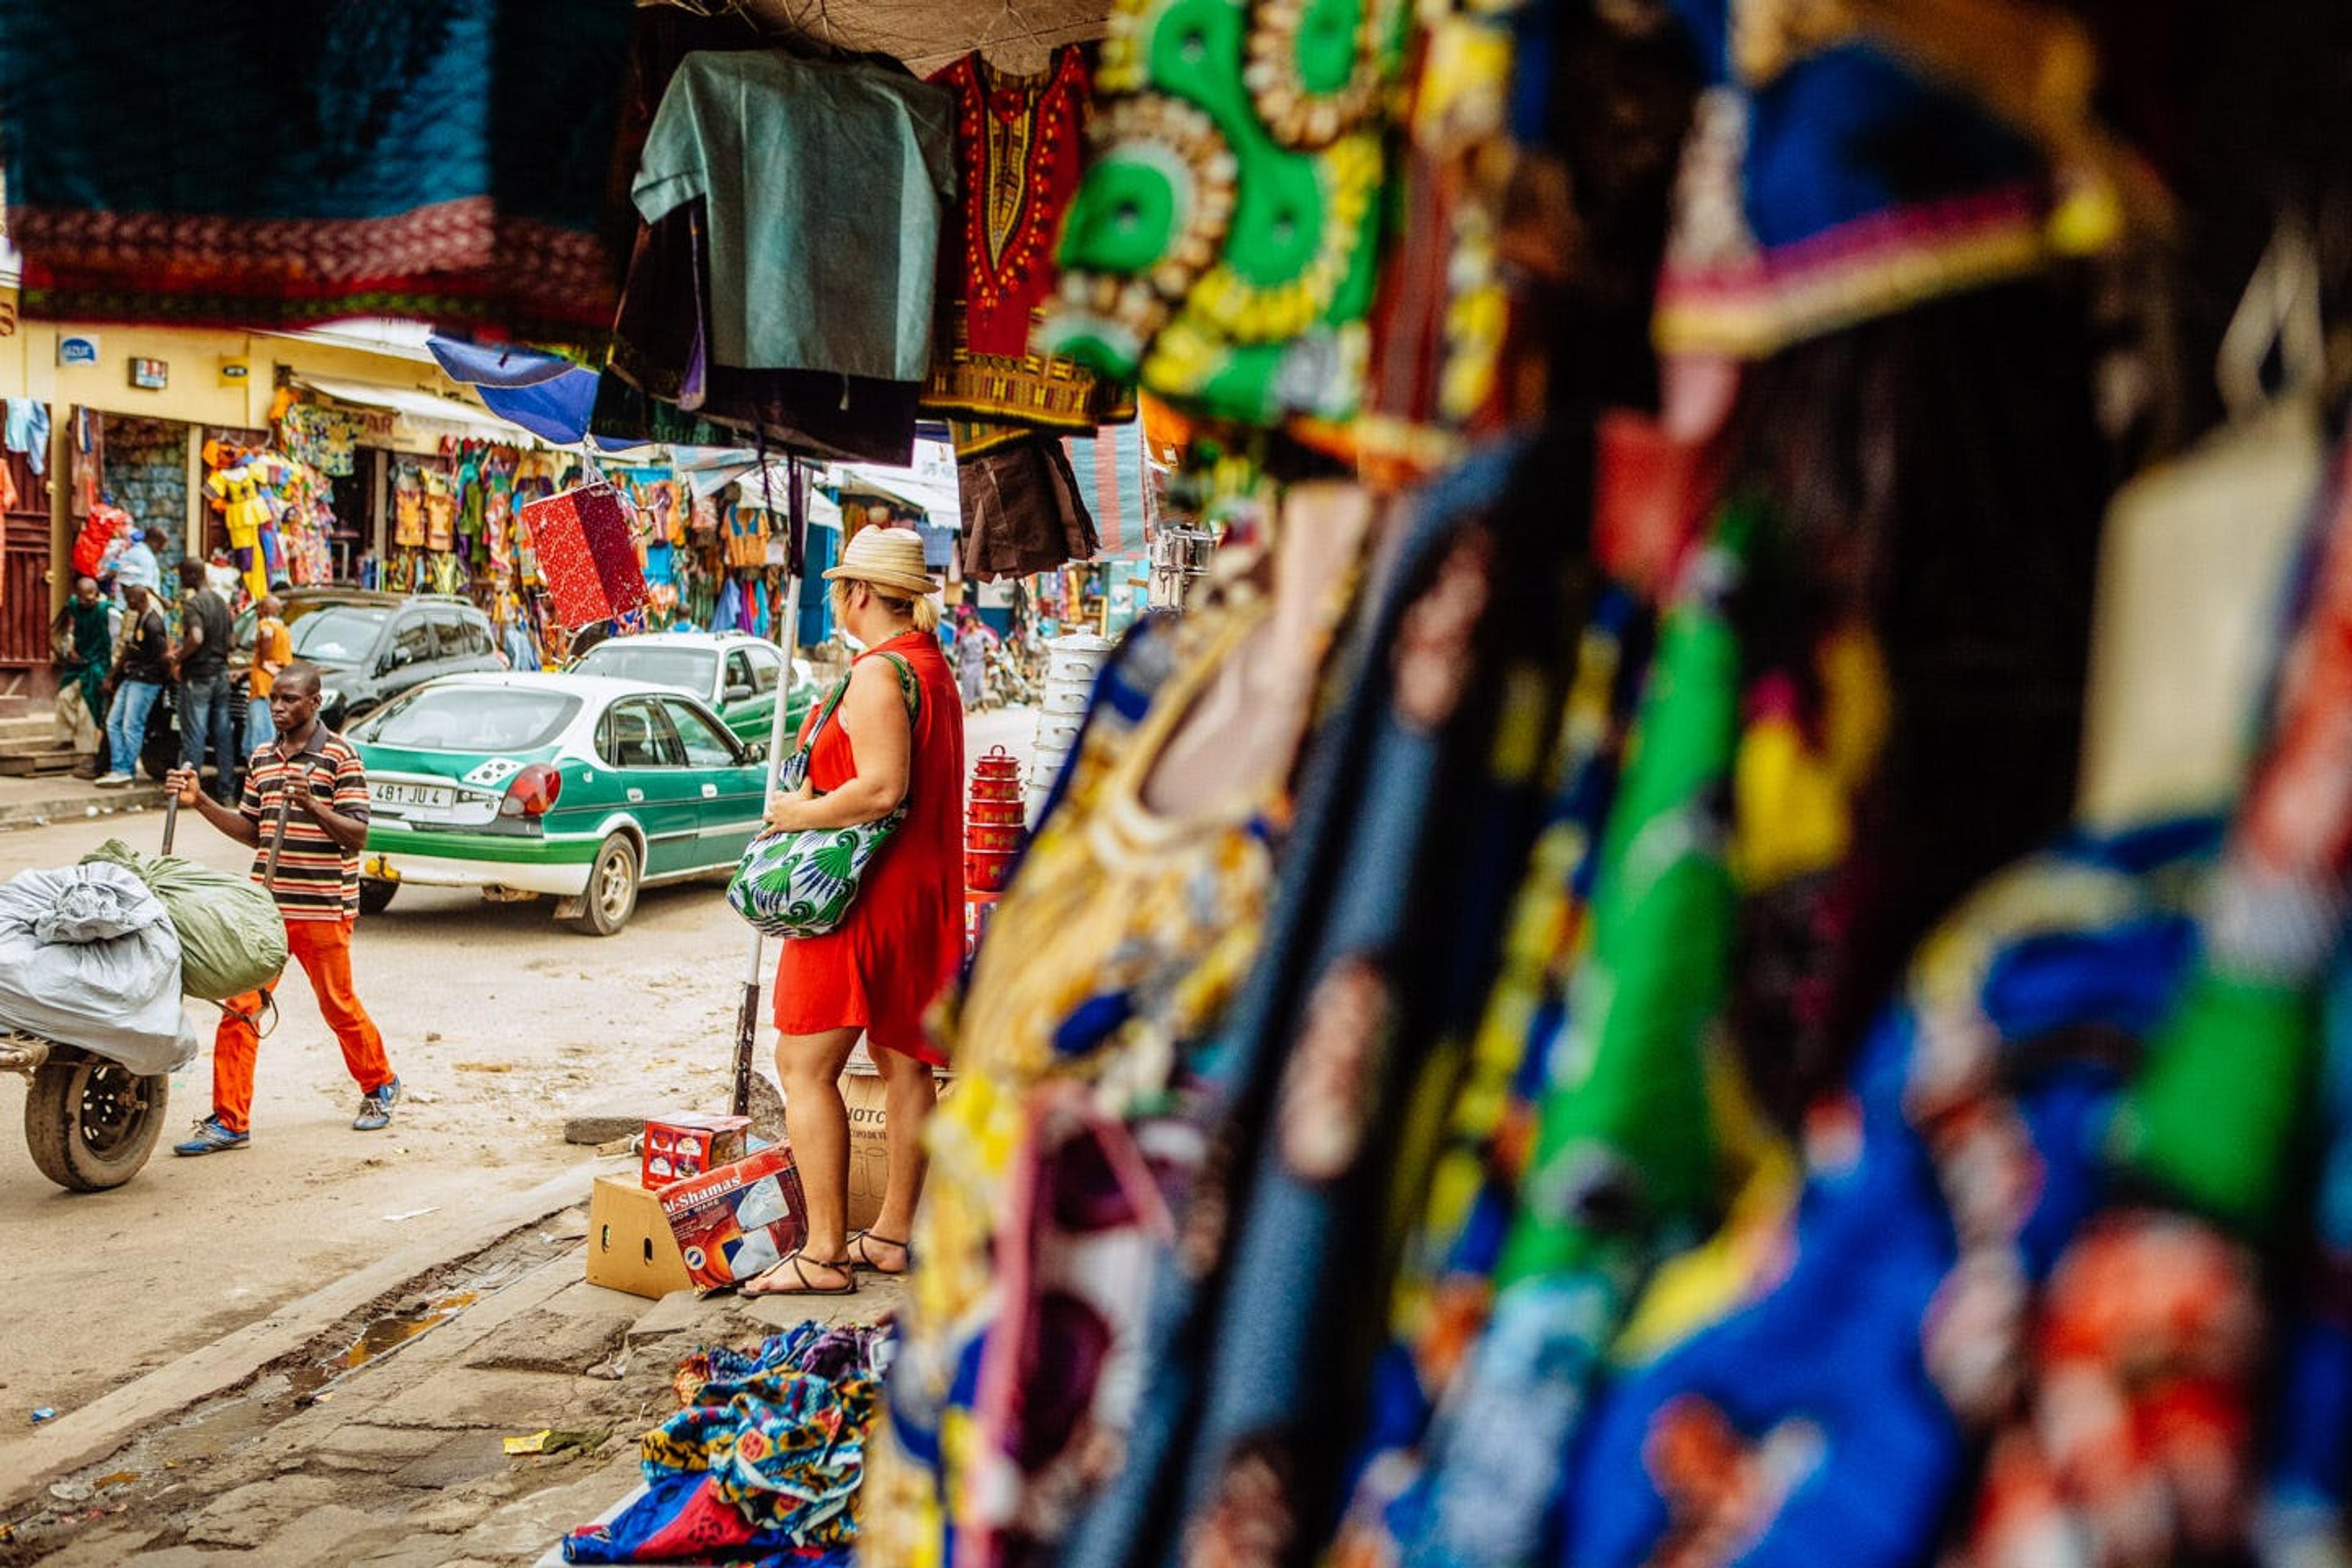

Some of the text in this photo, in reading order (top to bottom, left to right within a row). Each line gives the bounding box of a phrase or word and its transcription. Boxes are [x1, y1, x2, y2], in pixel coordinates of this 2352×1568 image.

[377, 785, 439, 804] 481 JU 4
